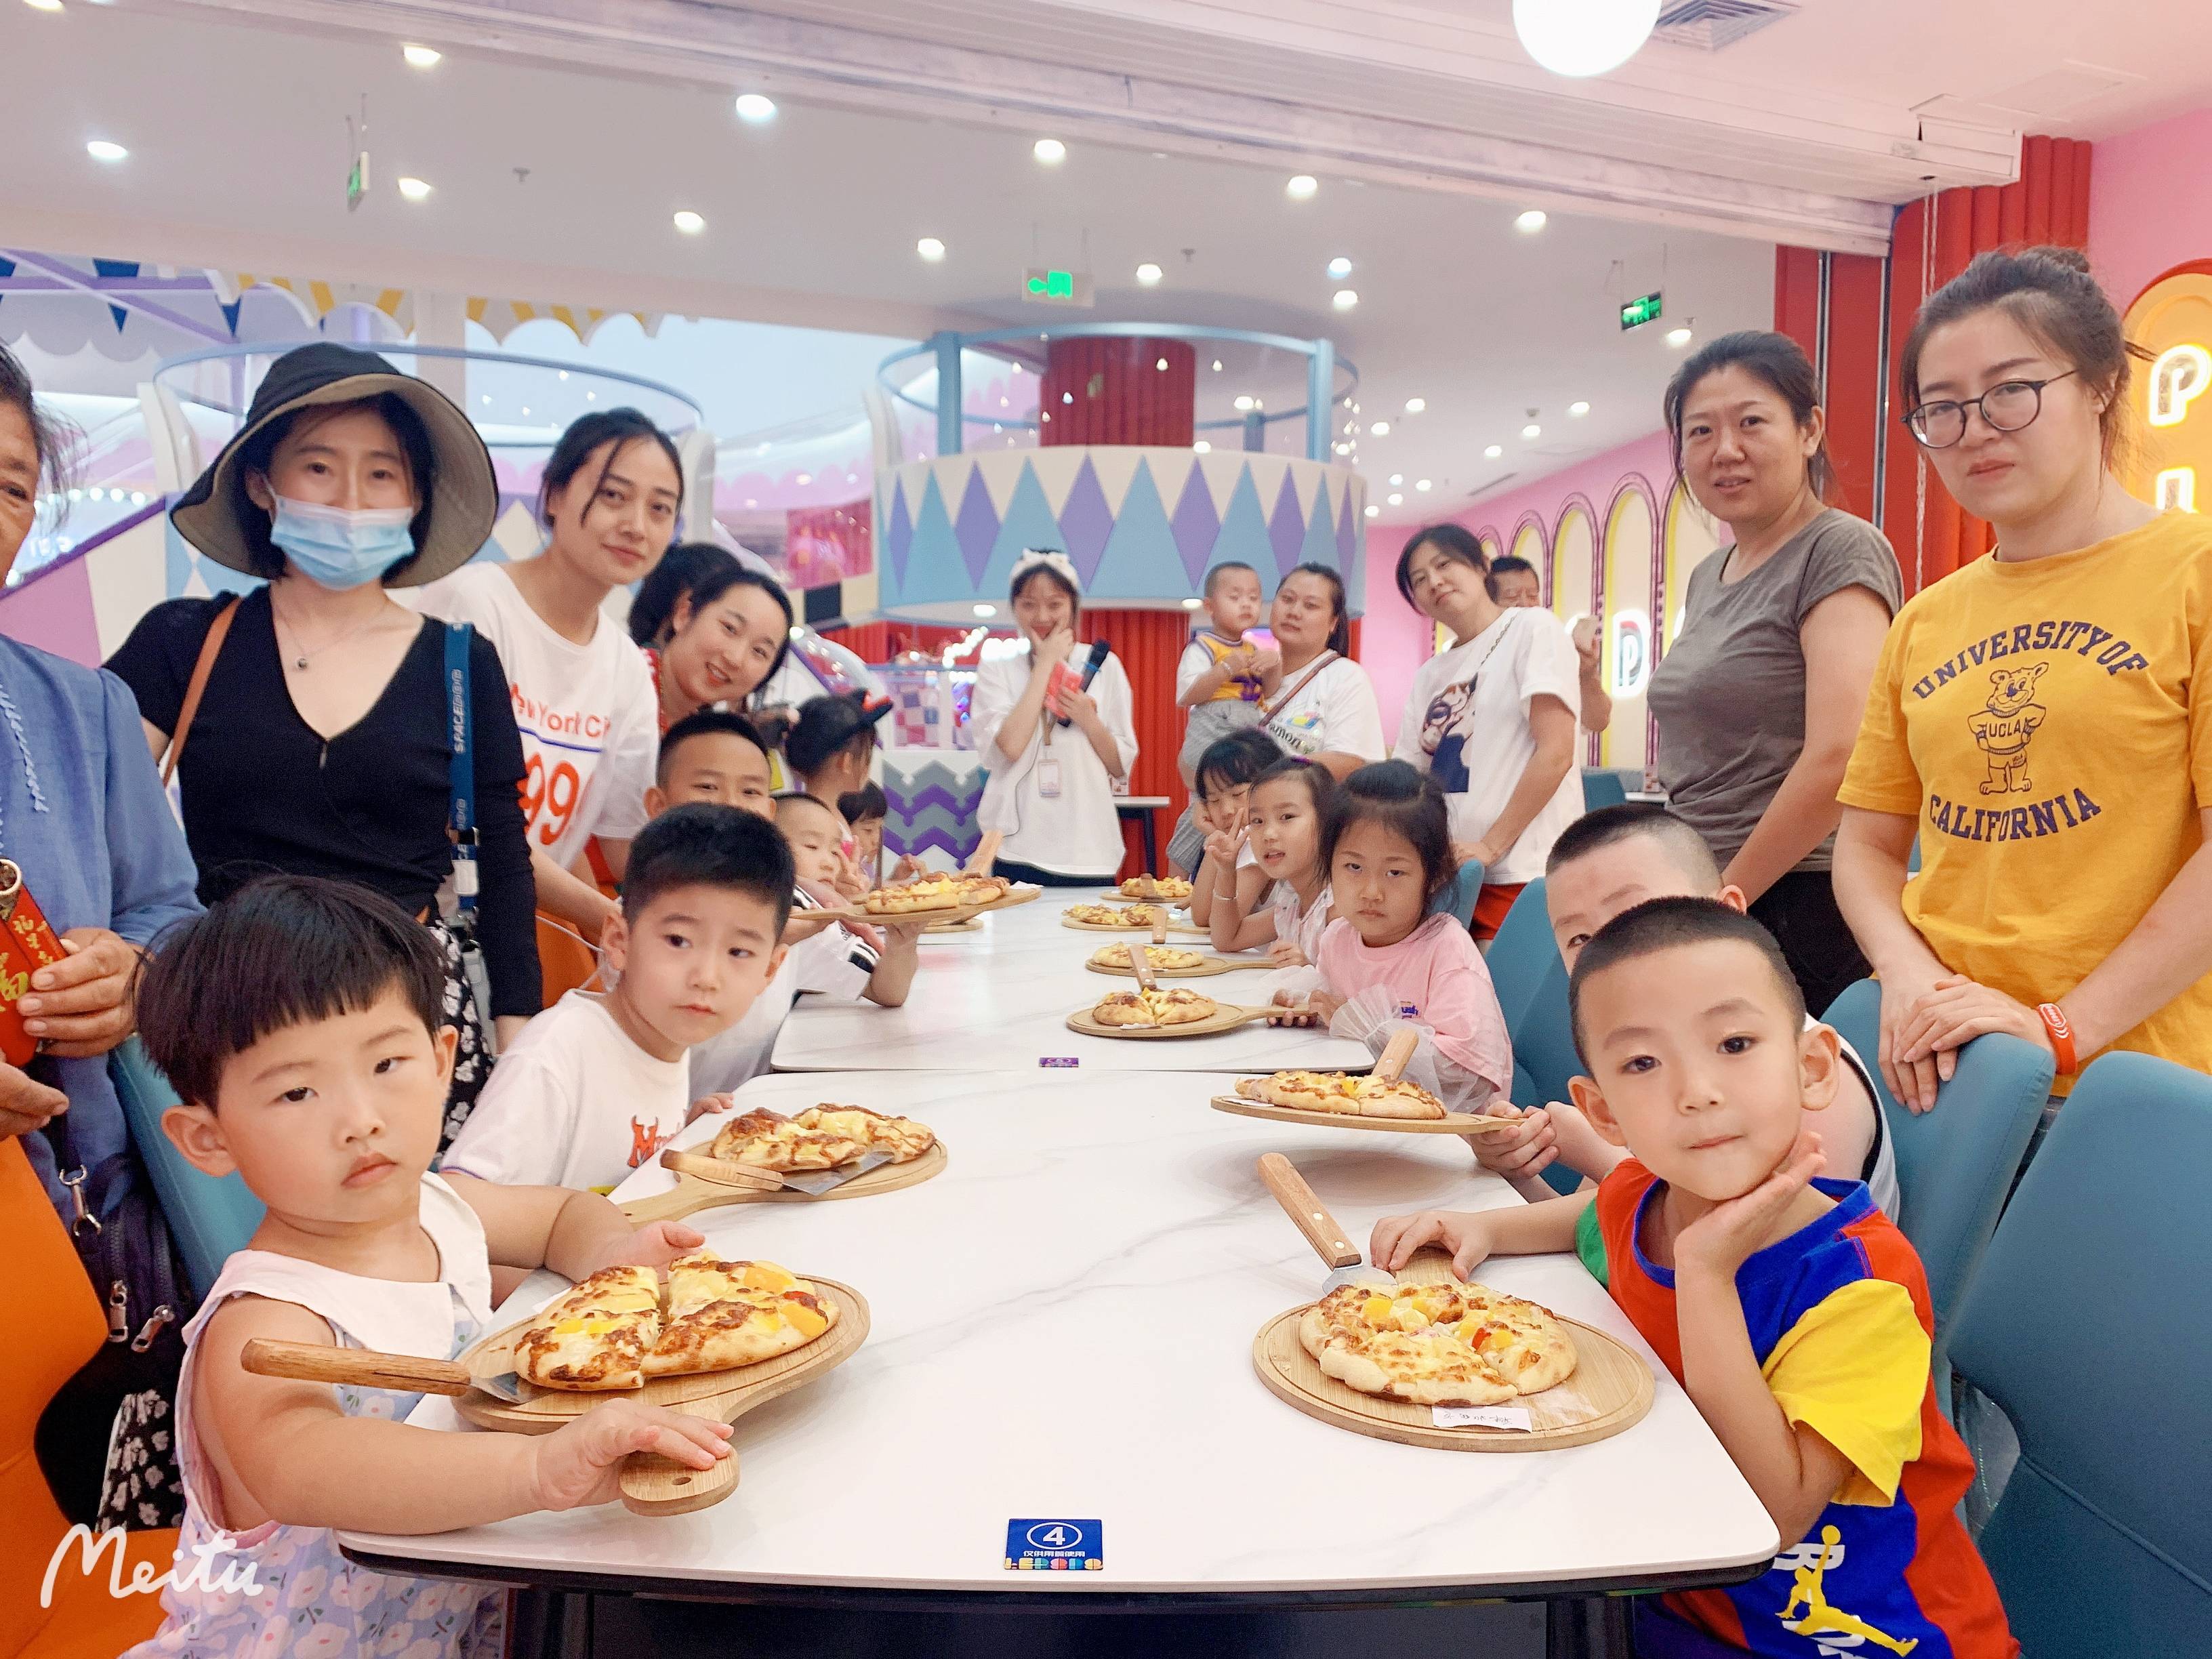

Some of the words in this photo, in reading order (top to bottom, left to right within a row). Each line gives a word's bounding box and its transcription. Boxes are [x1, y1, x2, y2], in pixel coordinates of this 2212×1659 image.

[1912, 620, 2113, 699] UNIVERSITY
[2095, 640, 2150, 676] OF
[1988, 720, 2021, 738] UCLA
[1929, 787, 2102, 842] CALIFORNIA
